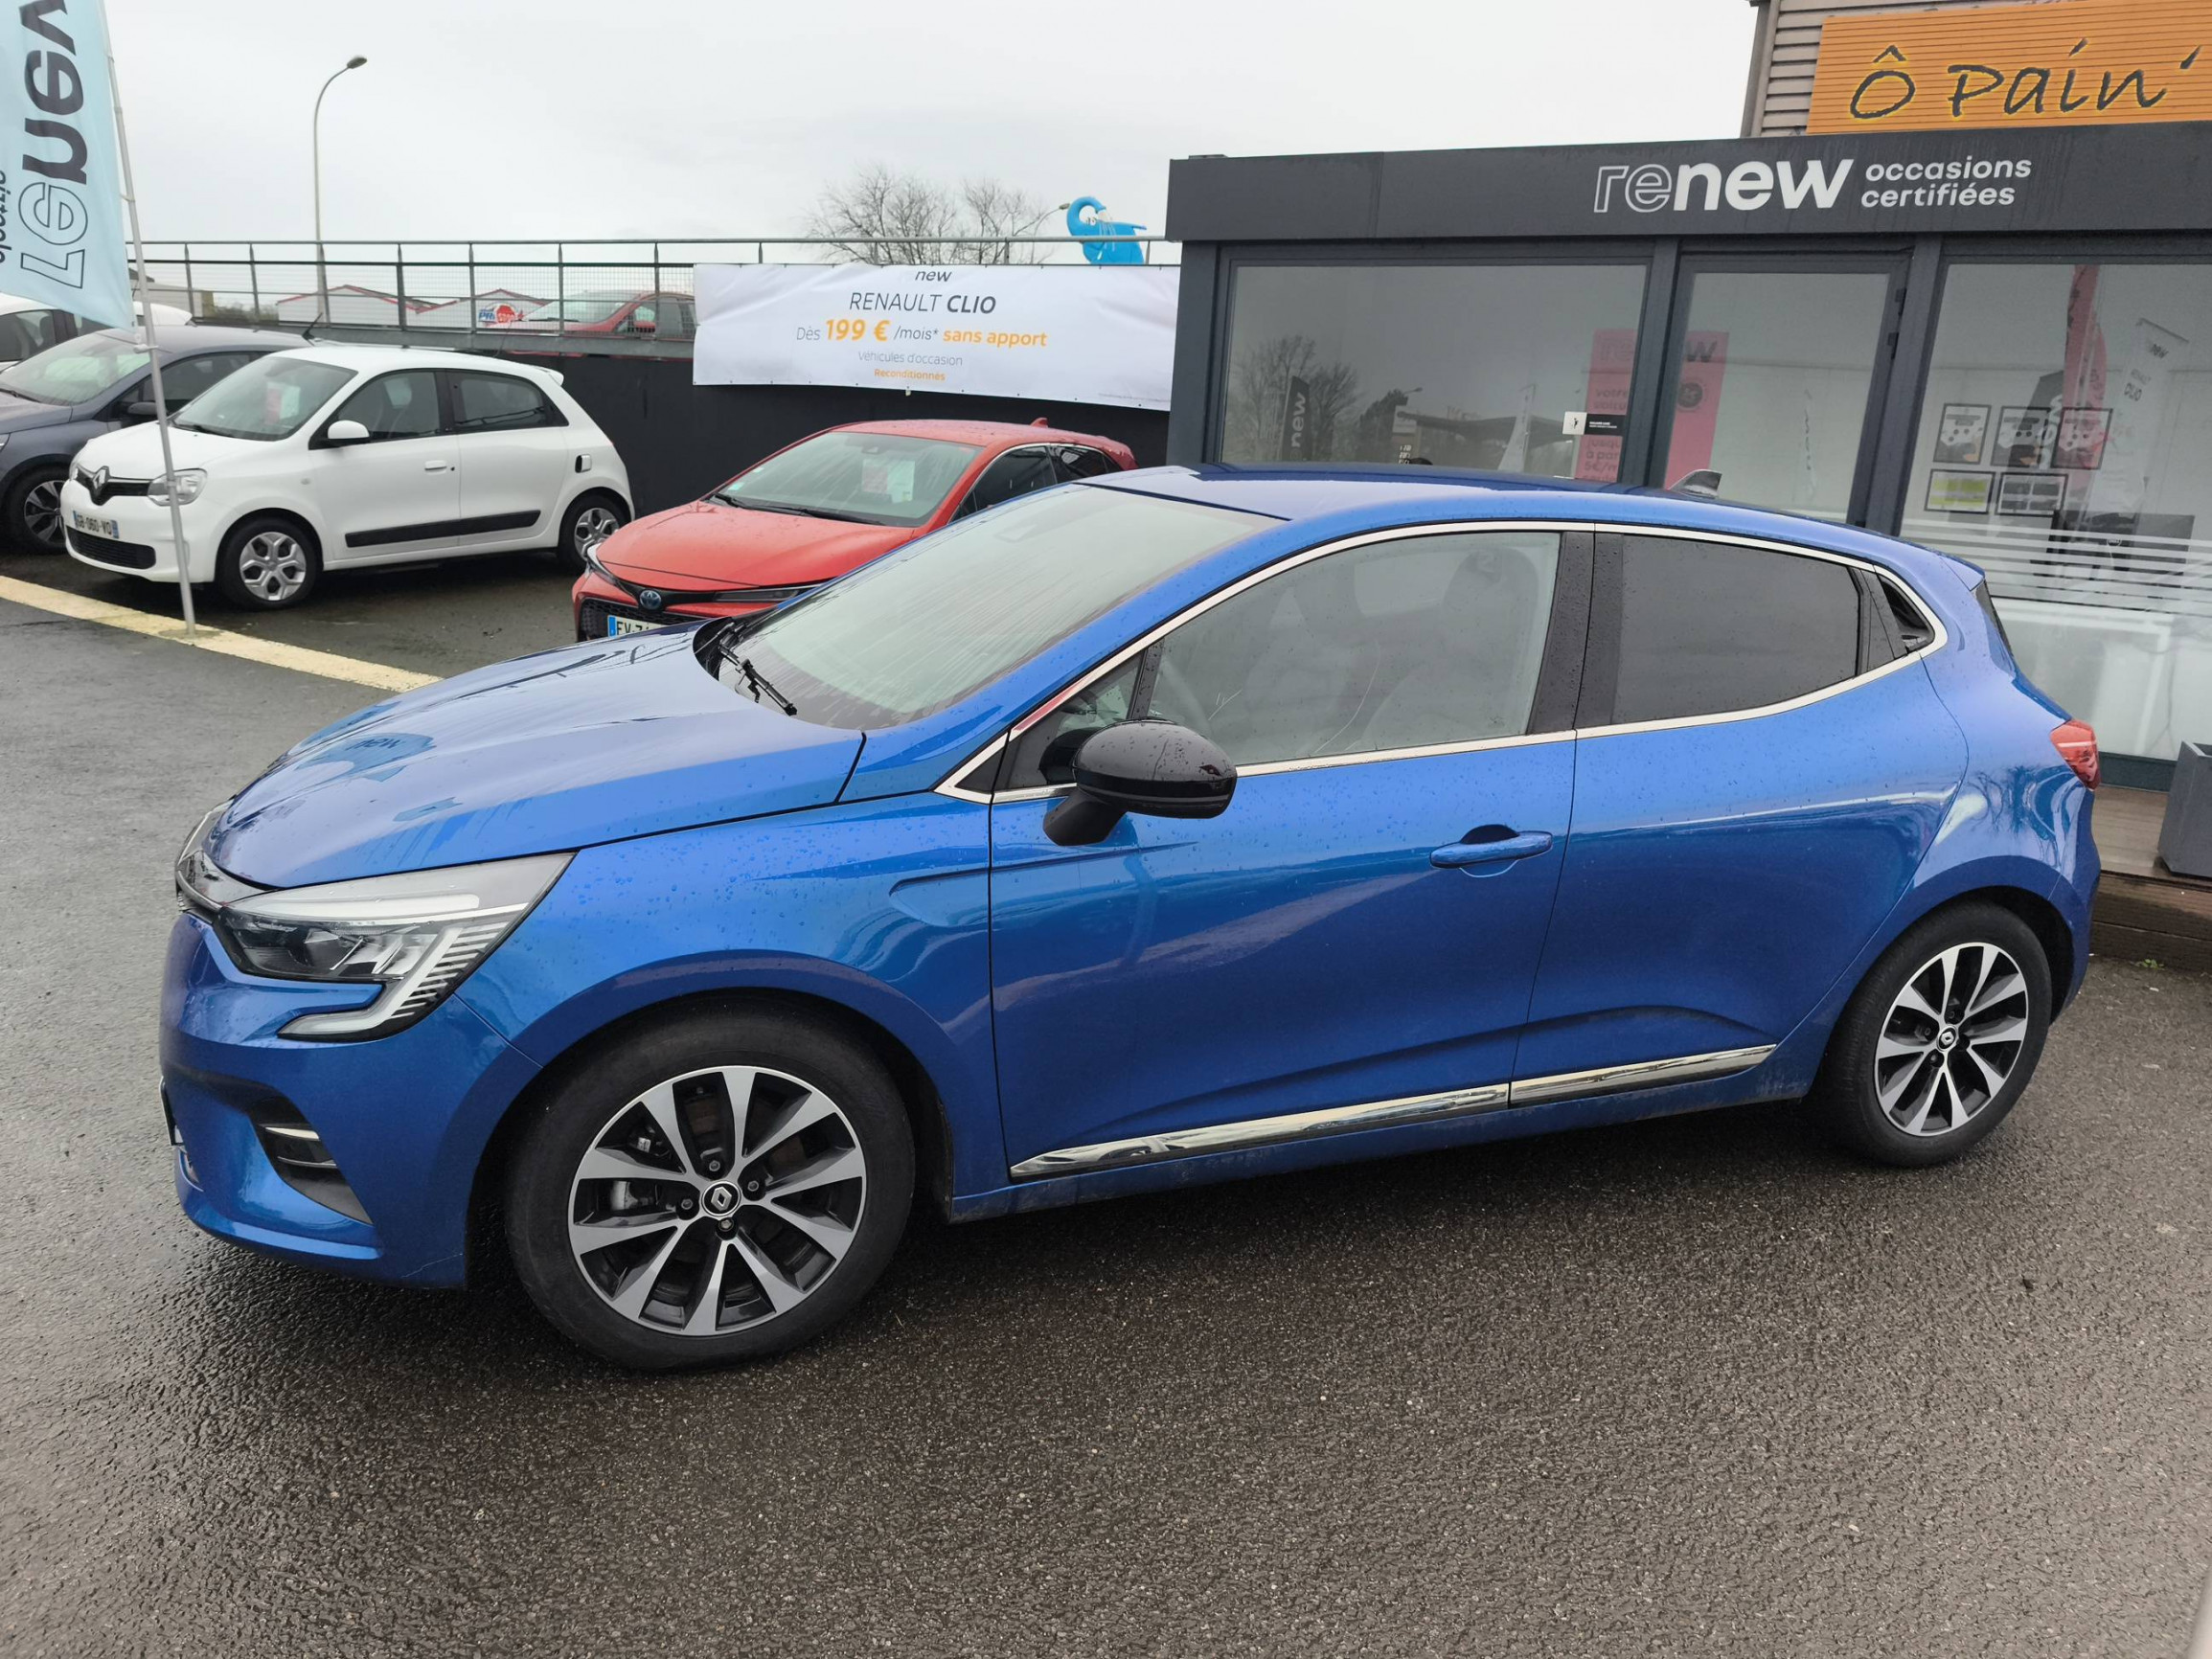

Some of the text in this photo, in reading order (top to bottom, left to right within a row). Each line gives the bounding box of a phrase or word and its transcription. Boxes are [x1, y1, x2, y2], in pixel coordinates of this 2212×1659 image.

[1849, 44, 1916, 120] Ô
[1864, 155, 2033, 182] occasions
[1593, 158, 1855, 214] renew
[1860, 182, 2017, 209] certifiées
[915, 270, 952, 284] new
[849, 292, 996, 314] RENAULT CLIO
[796, 326, 821, 341] Dès
[826, 319, 866, 341] 199
[874, 320, 891, 342] €
[943, 330, 984, 344] sans
[986, 330, 1048, 349] apport
[857, 351, 963, 367] Véhicules d'occasion
